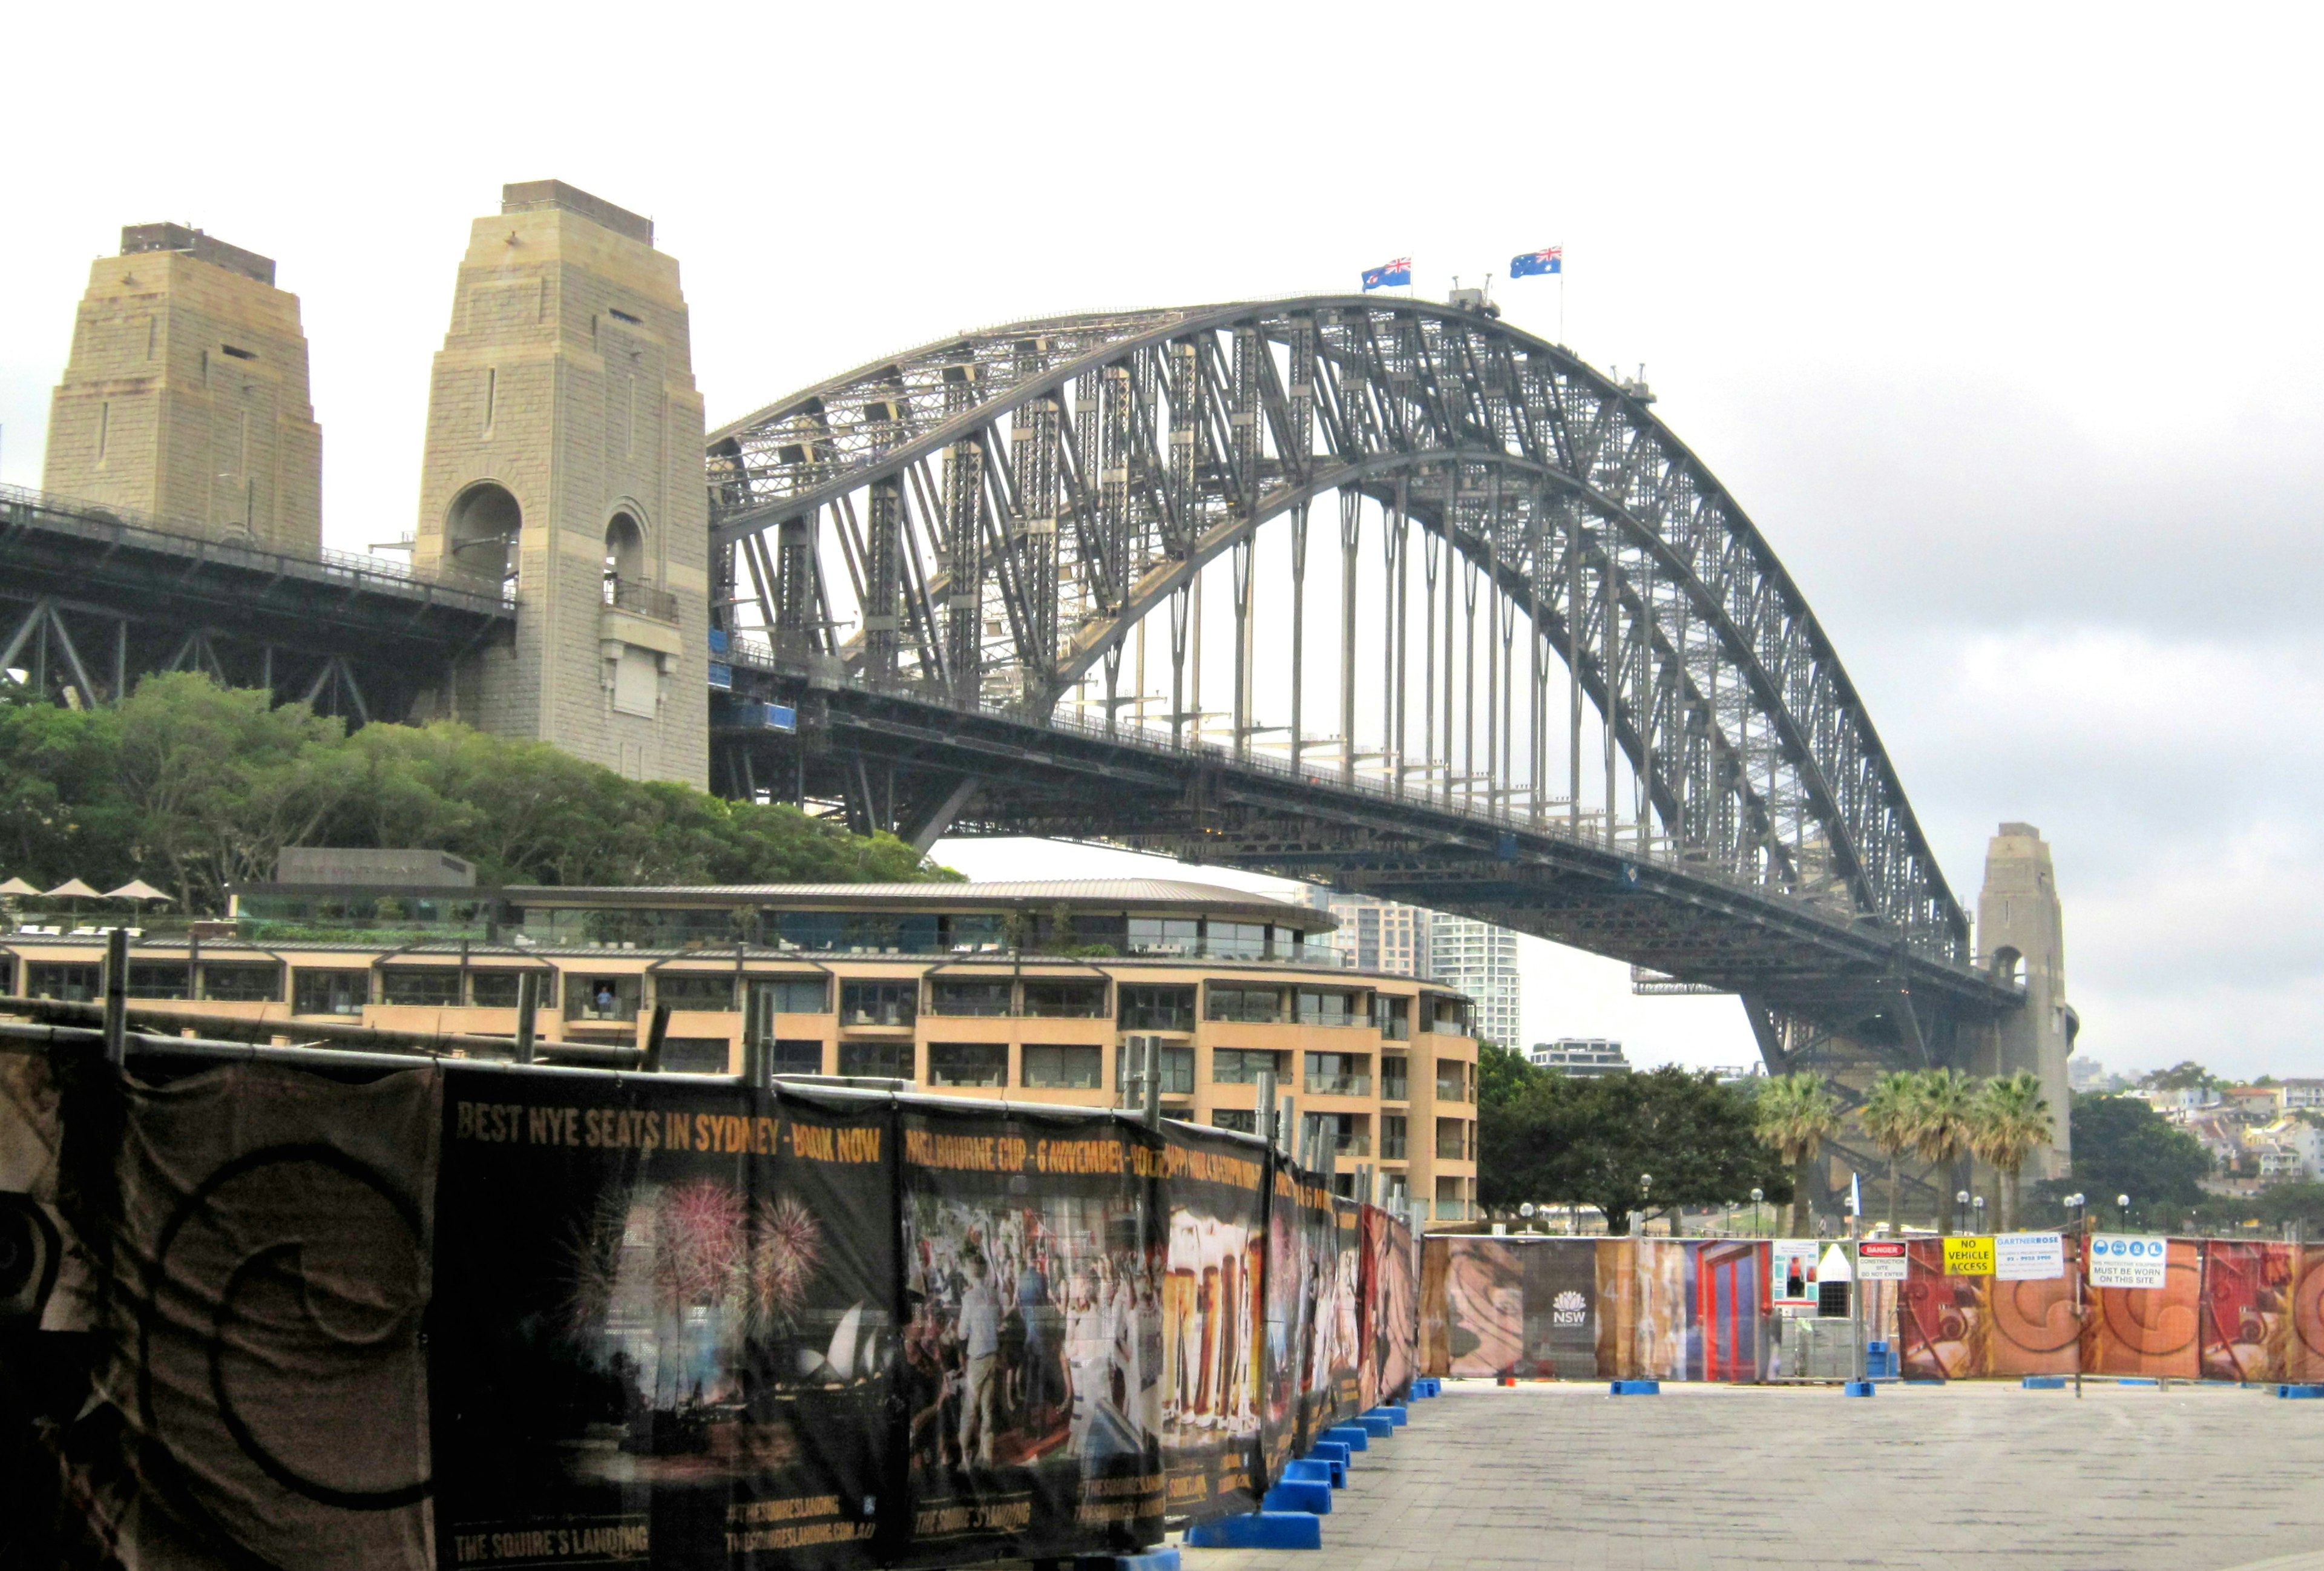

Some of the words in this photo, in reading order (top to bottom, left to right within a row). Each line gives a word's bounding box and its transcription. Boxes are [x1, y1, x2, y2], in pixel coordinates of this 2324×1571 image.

[456, 1101, 522, 1143] BEST
[528, 1107, 580, 1146] NYE
[585, 1108, 660, 1149] SEATS
[665, 1112, 690, 1150] IN
[695, 1113, 780, 1155] SYDNEY
[791, 1122, 835, 1162] BOOK
[837, 1128, 881, 1163] NOW
[905, 1128, 996, 1171] MELBOURNE
[998, 1137, 1027, 1171] CUP
[1036, 1139, 1047, 1172] 6
[1049, 1139, 1124, 1173] NOVEMBER
[1961, 1240, 1976, 1248] NO
[1997, 1237, 2059, 1245] GARTNERROSE
[1948, 1251, 1989, 1260] VEHICLE
[1951, 1262, 1988, 1271] ACCESS
[2094, 1266, 2118, 1275] MUST
[1554, 1311, 1586, 1323] NSW
[454, 1533, 488, 1562] THE
[491, 1529, 570, 1559] SQUIRE'S
[572, 1525, 649, 1555] LANDING
